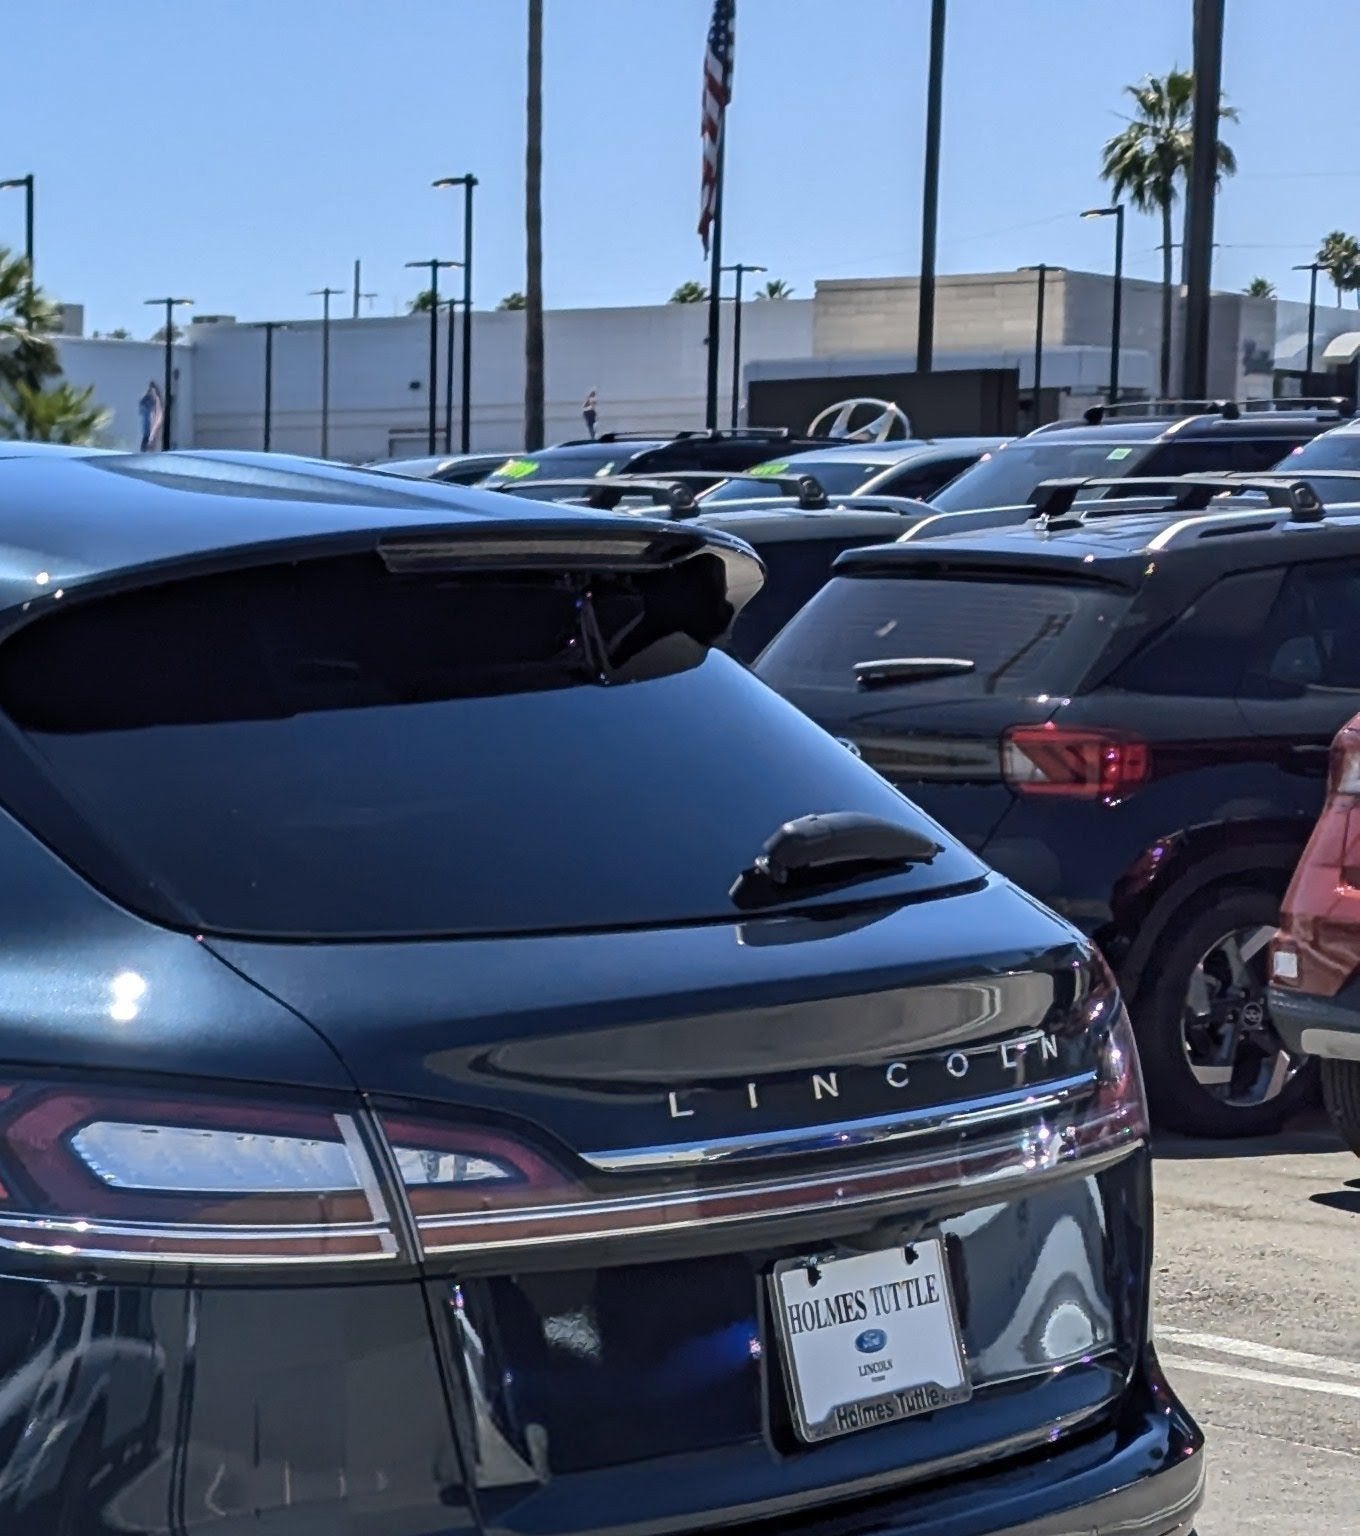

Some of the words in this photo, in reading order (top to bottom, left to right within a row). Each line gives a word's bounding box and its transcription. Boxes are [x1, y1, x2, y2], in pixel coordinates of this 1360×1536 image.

[669, 1034, 1058, 1117] LINCOLN
[788, 1290, 867, 1334] HOLMES
[870, 1274, 940, 1316] TUTTLE
[835, 1401, 895, 1431] Holmes
[893, 1386, 941, 1415] Tuttle
